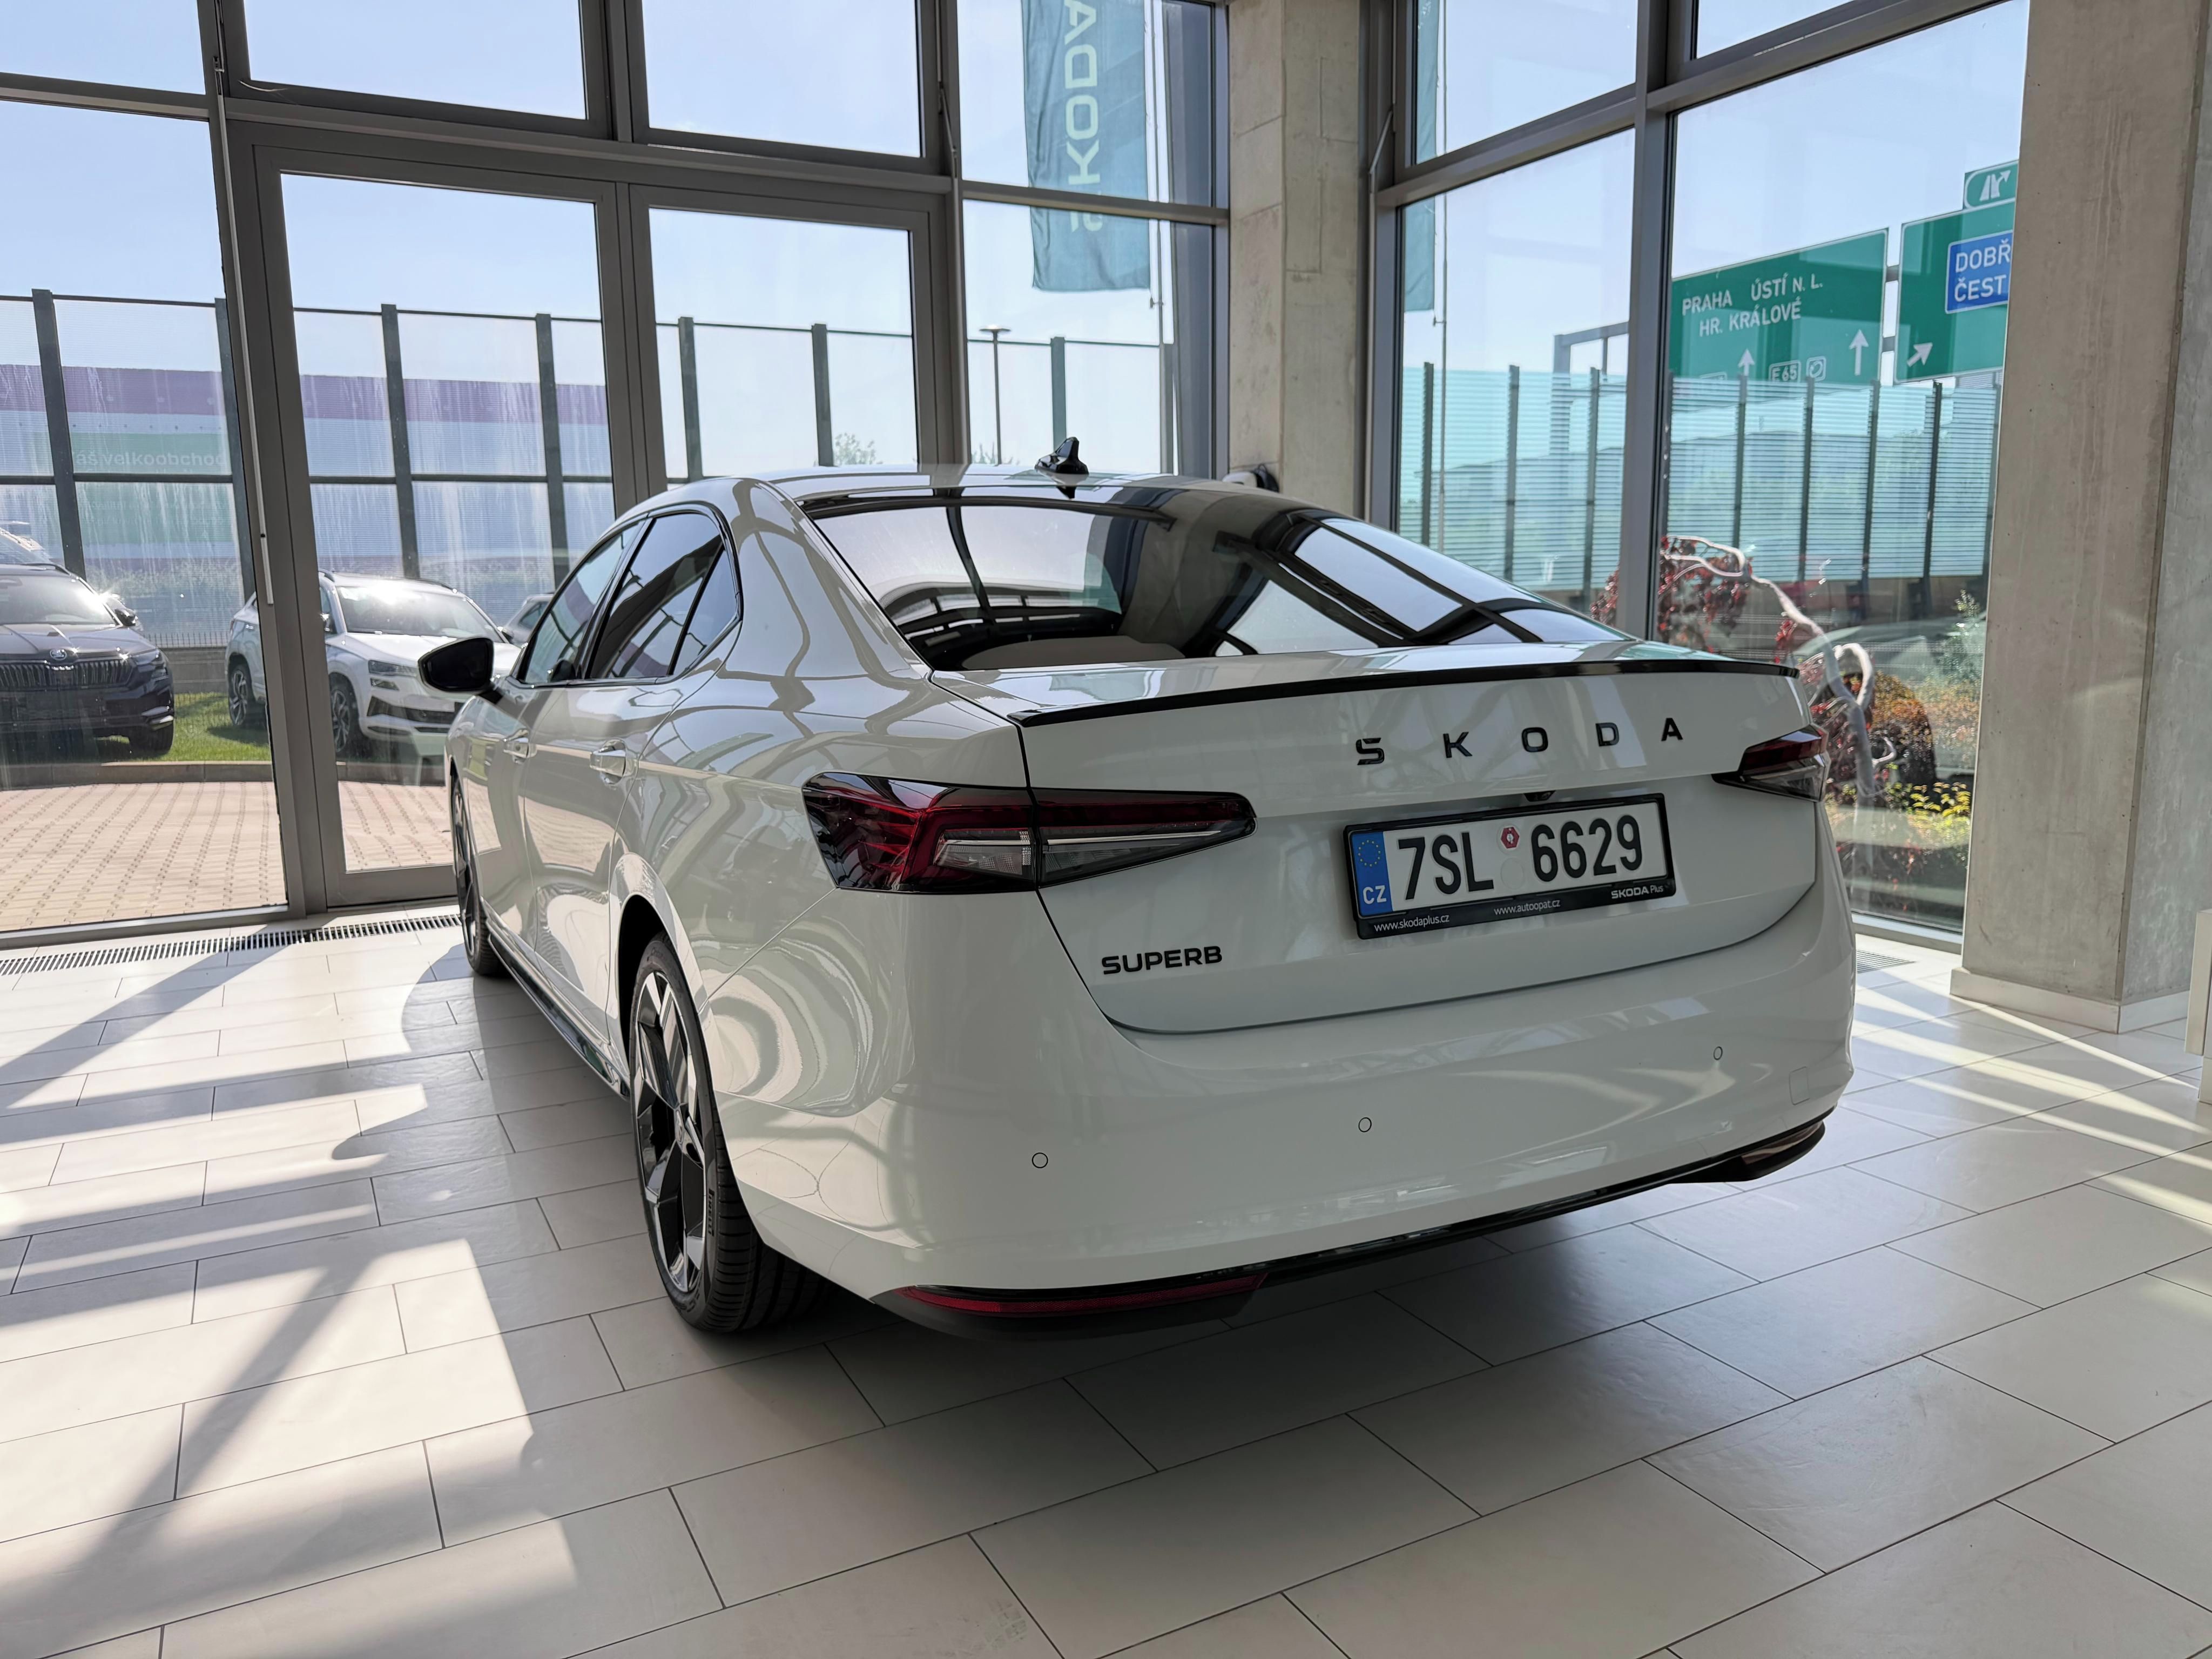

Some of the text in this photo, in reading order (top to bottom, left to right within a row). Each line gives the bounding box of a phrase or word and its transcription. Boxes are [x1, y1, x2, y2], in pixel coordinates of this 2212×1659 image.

[1955, 238, 2011, 273] DOBŘ
[1682, 273, 1823, 315] PRAHA ÚSTÍ N. L.
[1954, 276, 2007, 302] ČEST
[1700, 296, 1802, 337] HR. KRÁLOVÉ
[1772, 365, 1798, 381] E 65
[76, 449, 98, 466] áš
[1355, 718, 1683, 765] SKODA
[1398, 814, 1643, 900] 7SL 6629
[1363, 885, 1387, 905] CZ
[1611, 885, 1664, 899] SKODA Plus
[1494, 899, 1560, 915] www.autoopat.cz
[1374, 914, 1450, 932] www.skodaplus.cz
[1102, 946, 1223, 975] SUPERB
